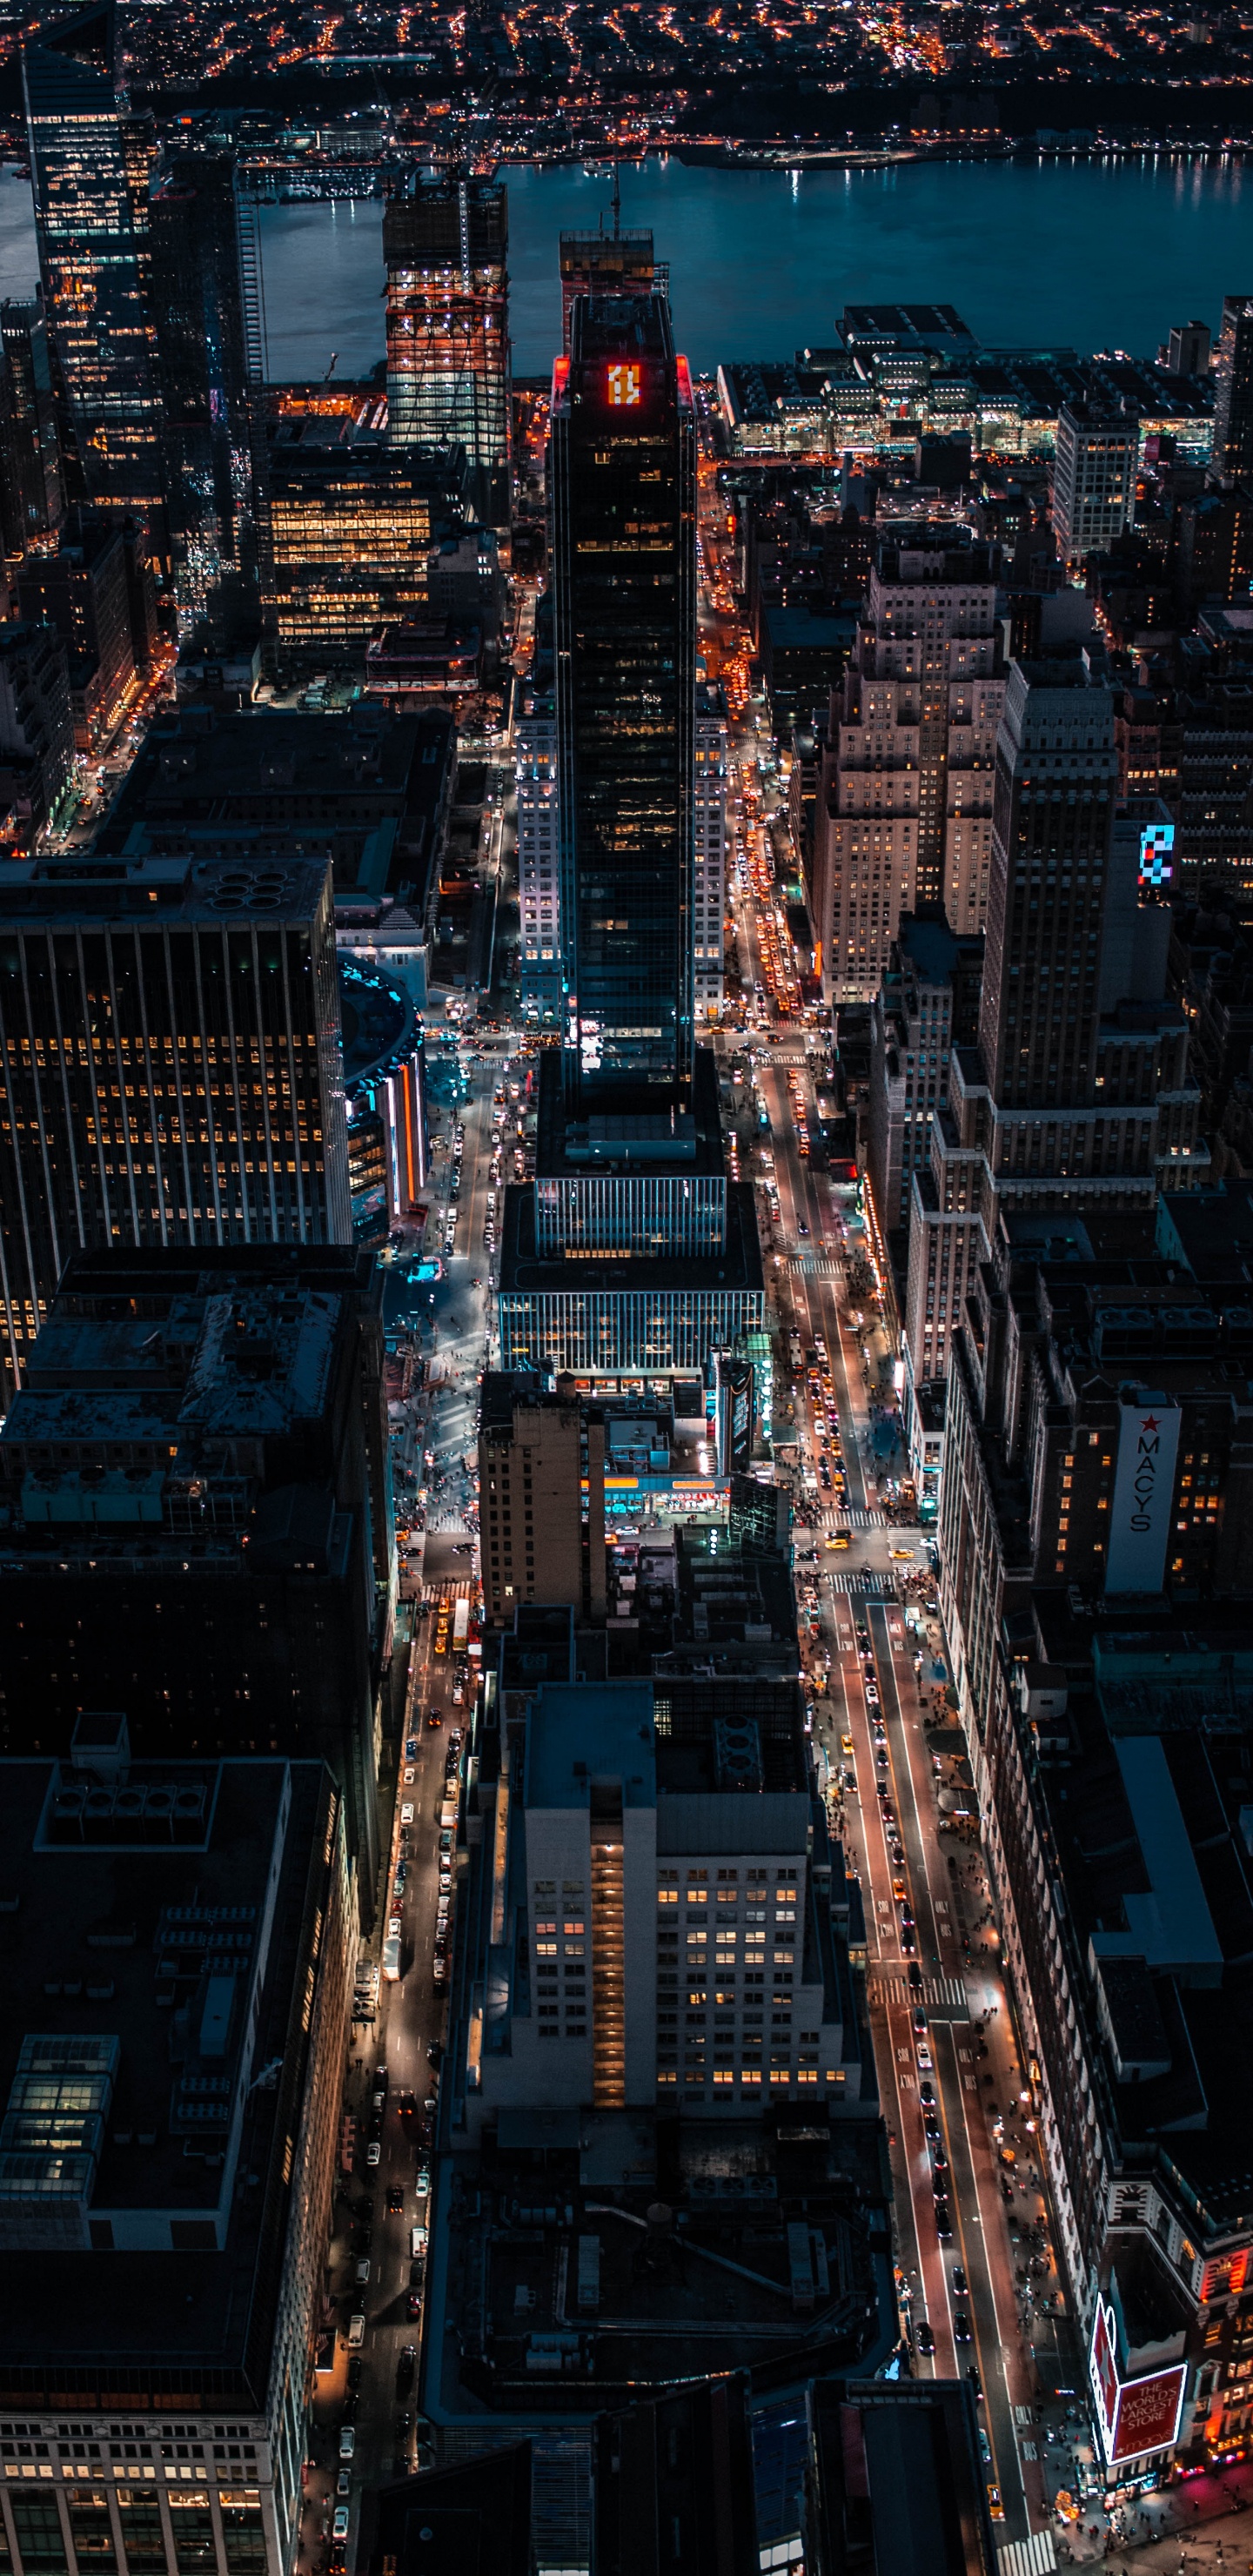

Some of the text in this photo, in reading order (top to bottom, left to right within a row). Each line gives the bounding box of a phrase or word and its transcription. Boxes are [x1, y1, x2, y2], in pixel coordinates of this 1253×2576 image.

[1129, 1436, 1160, 1532] MACYS
[1122, 2386, 1177, 2412] WORLD'S
[1138, 2381, 1163, 2397] THE
[1015, 2405, 1034, 2425] ONLY
[1120, 2397, 1175, 2423] LARGEST
[1127, 2410, 1165, 2430] STORE
[1022, 2440, 1038, 2461] BUS
